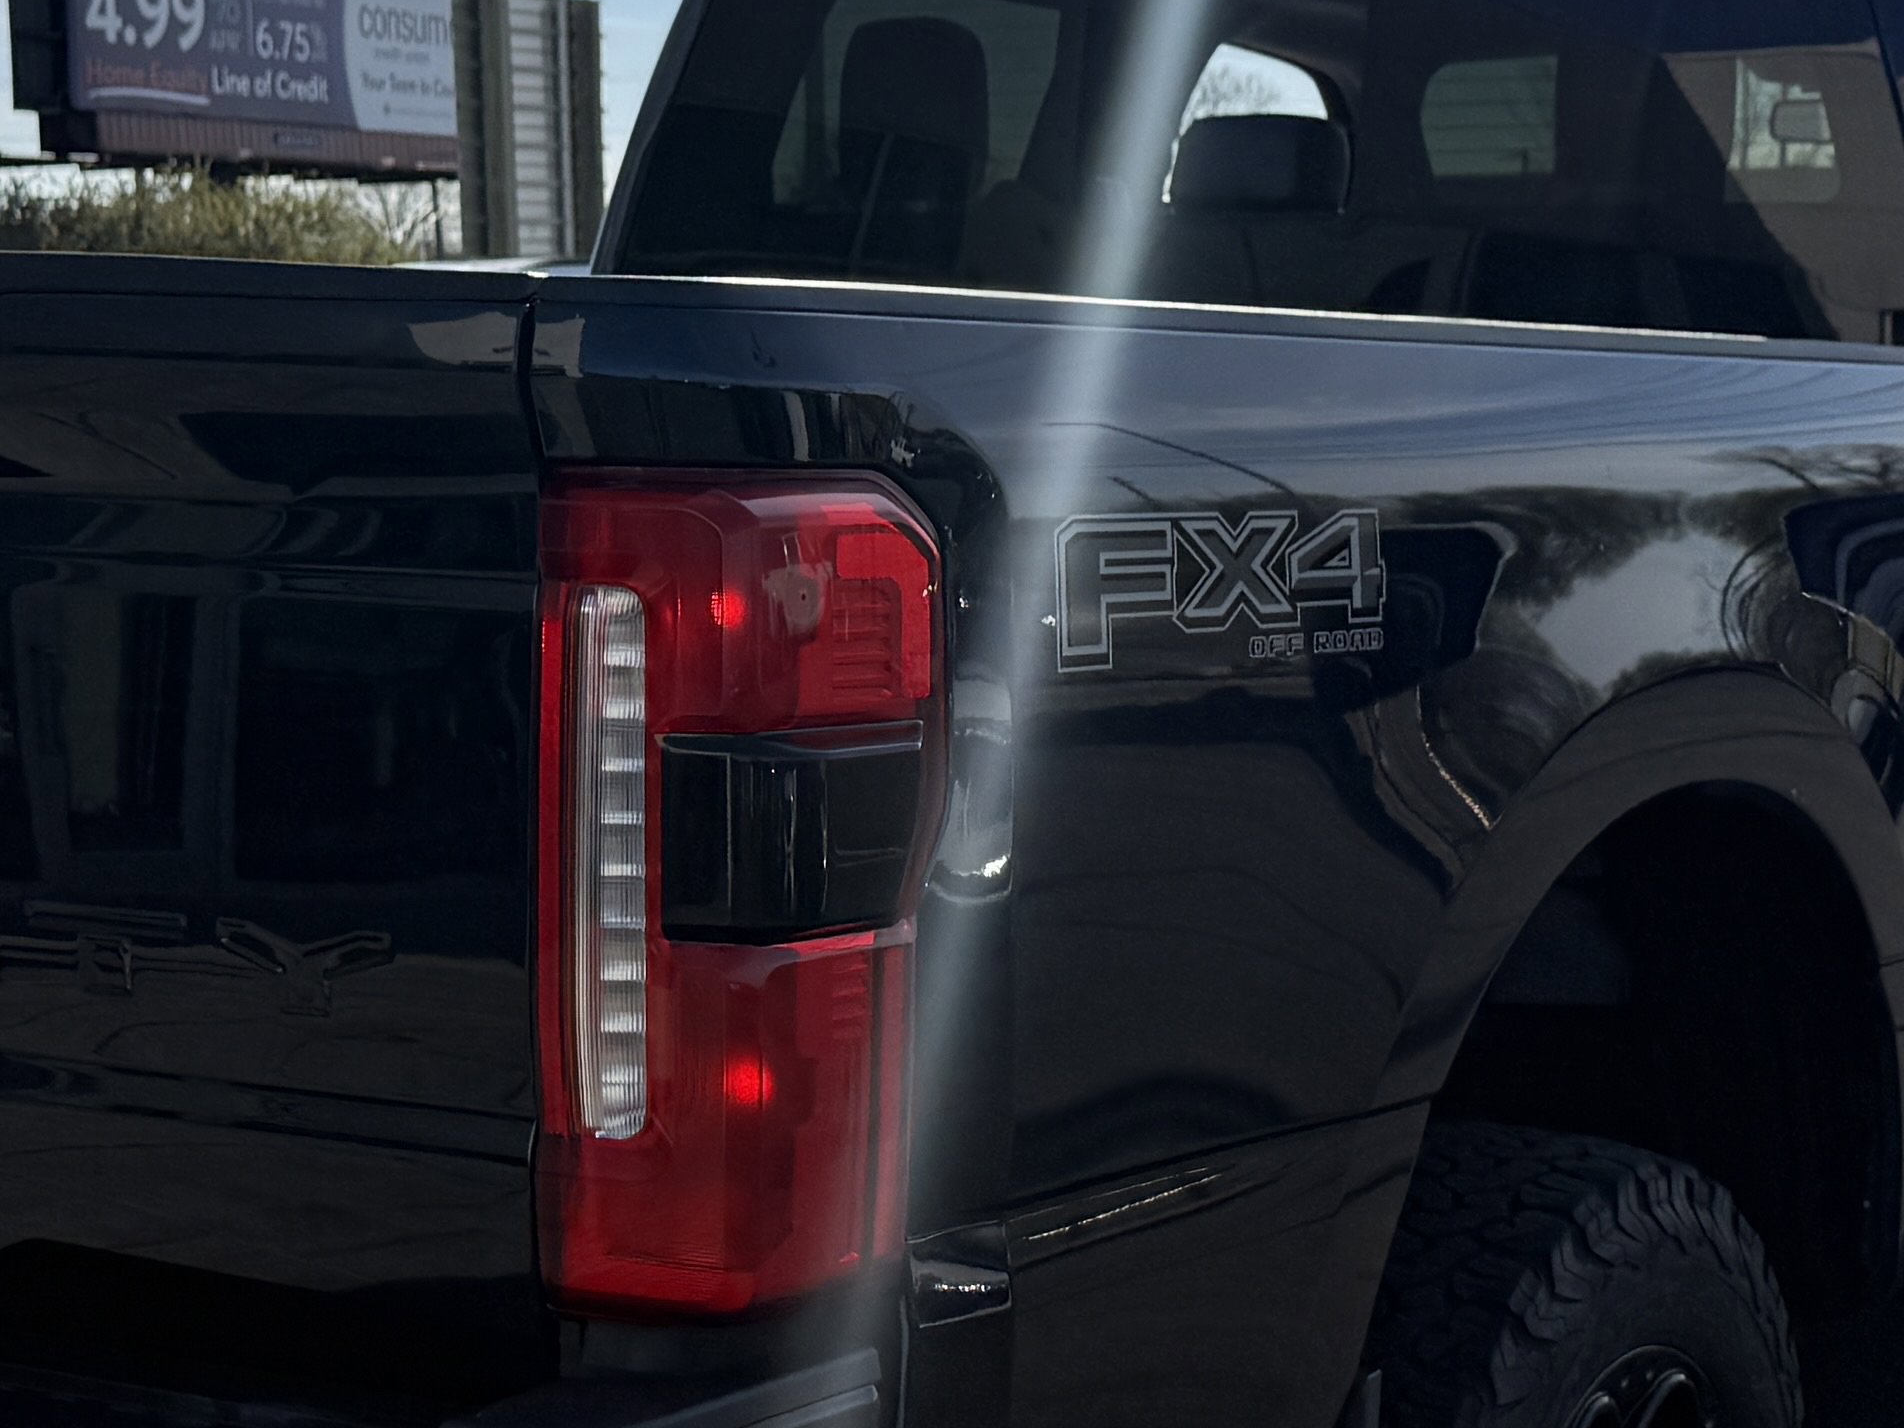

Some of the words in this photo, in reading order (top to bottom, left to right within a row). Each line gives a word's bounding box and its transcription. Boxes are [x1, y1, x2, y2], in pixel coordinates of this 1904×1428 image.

[255, 17, 311, 64] 6.75
[211, 63, 250, 98] Line
[252, 68, 273, 98] of
[275, 69, 330, 105] Credit
[1054, 508, 1387, 673] FX4
[1248, 632, 1305, 659] OFF
[1313, 626, 1385, 653] ROAD
